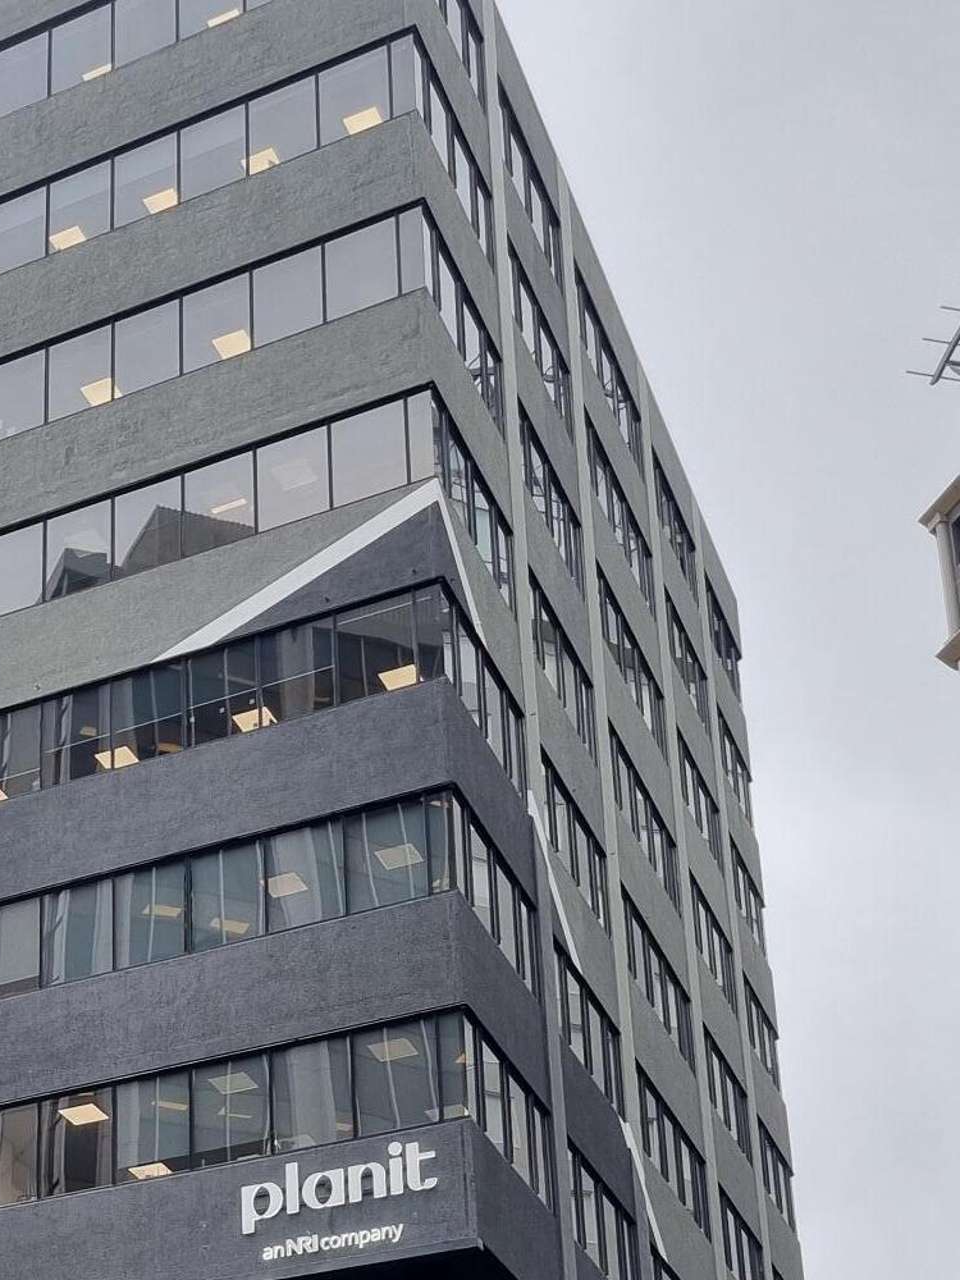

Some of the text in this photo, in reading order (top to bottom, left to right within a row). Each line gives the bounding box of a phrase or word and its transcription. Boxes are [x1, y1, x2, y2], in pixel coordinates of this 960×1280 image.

[241, 1141, 438, 1235] planit
[262, 1244, 285, 1260] an
[319, 1223, 404, 1249] company
